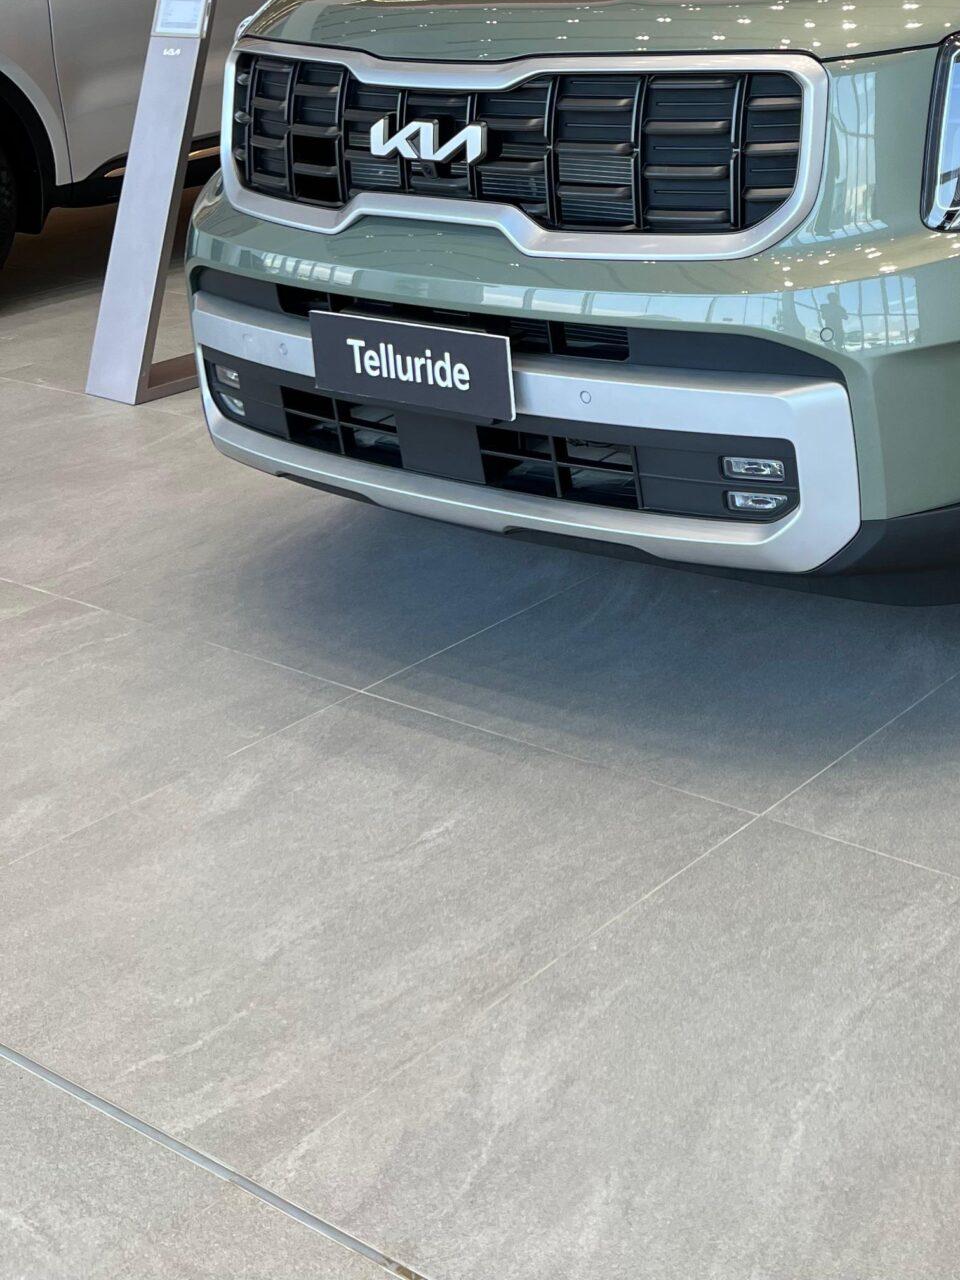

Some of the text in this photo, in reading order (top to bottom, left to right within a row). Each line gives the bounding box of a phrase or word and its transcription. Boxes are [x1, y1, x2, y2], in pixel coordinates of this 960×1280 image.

[163, 48, 181, 56] KIA
[370, 118, 487, 164] KIA
[346, 338, 470, 391] Telluride
